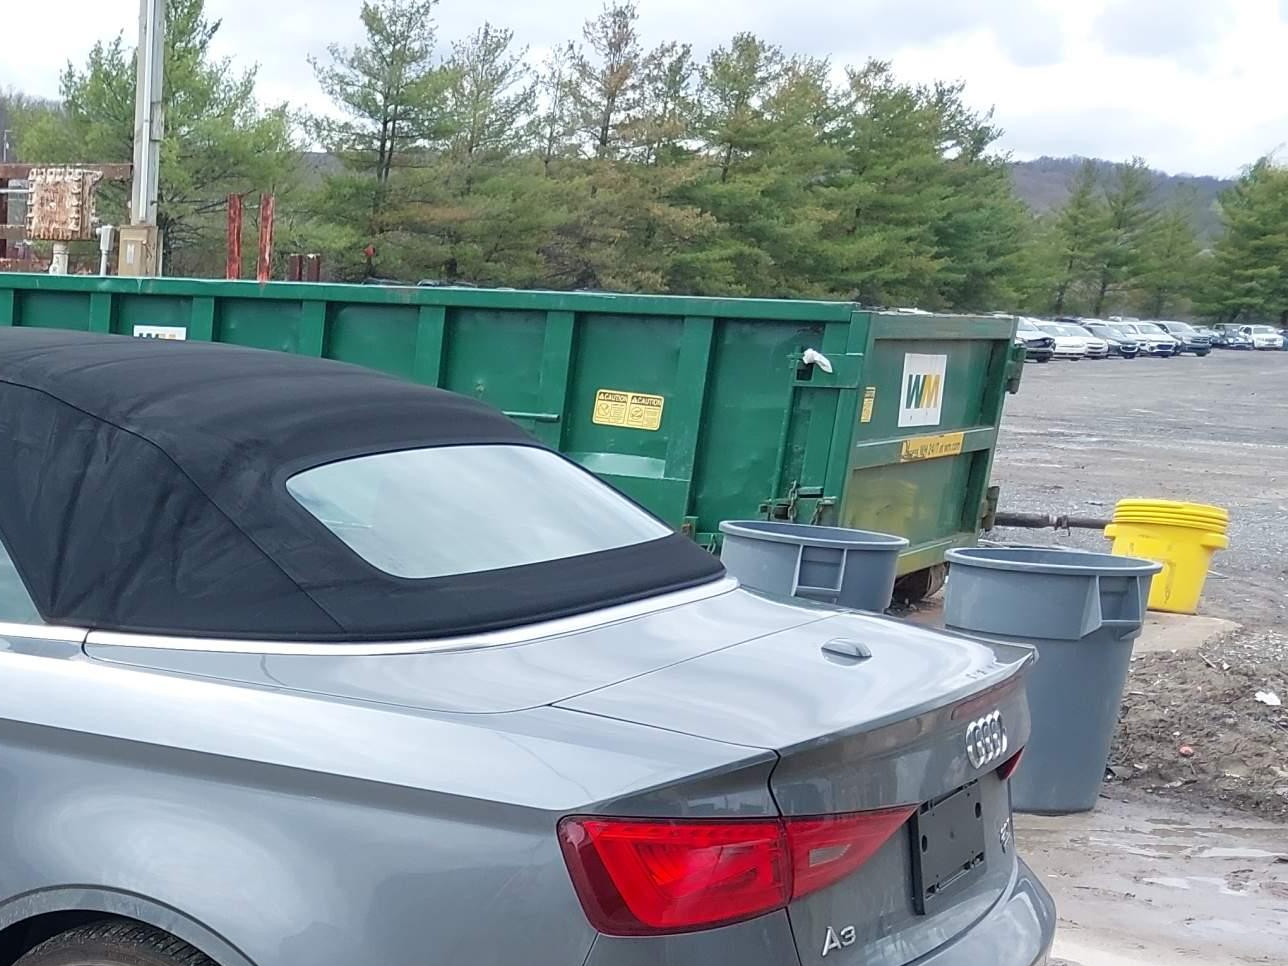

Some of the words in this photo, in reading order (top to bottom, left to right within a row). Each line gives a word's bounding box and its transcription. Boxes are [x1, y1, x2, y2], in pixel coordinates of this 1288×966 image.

[604, 393, 628, 402] CAUTION
[905, 373, 941, 410] WM
[822, 925, 857, 957] A3
